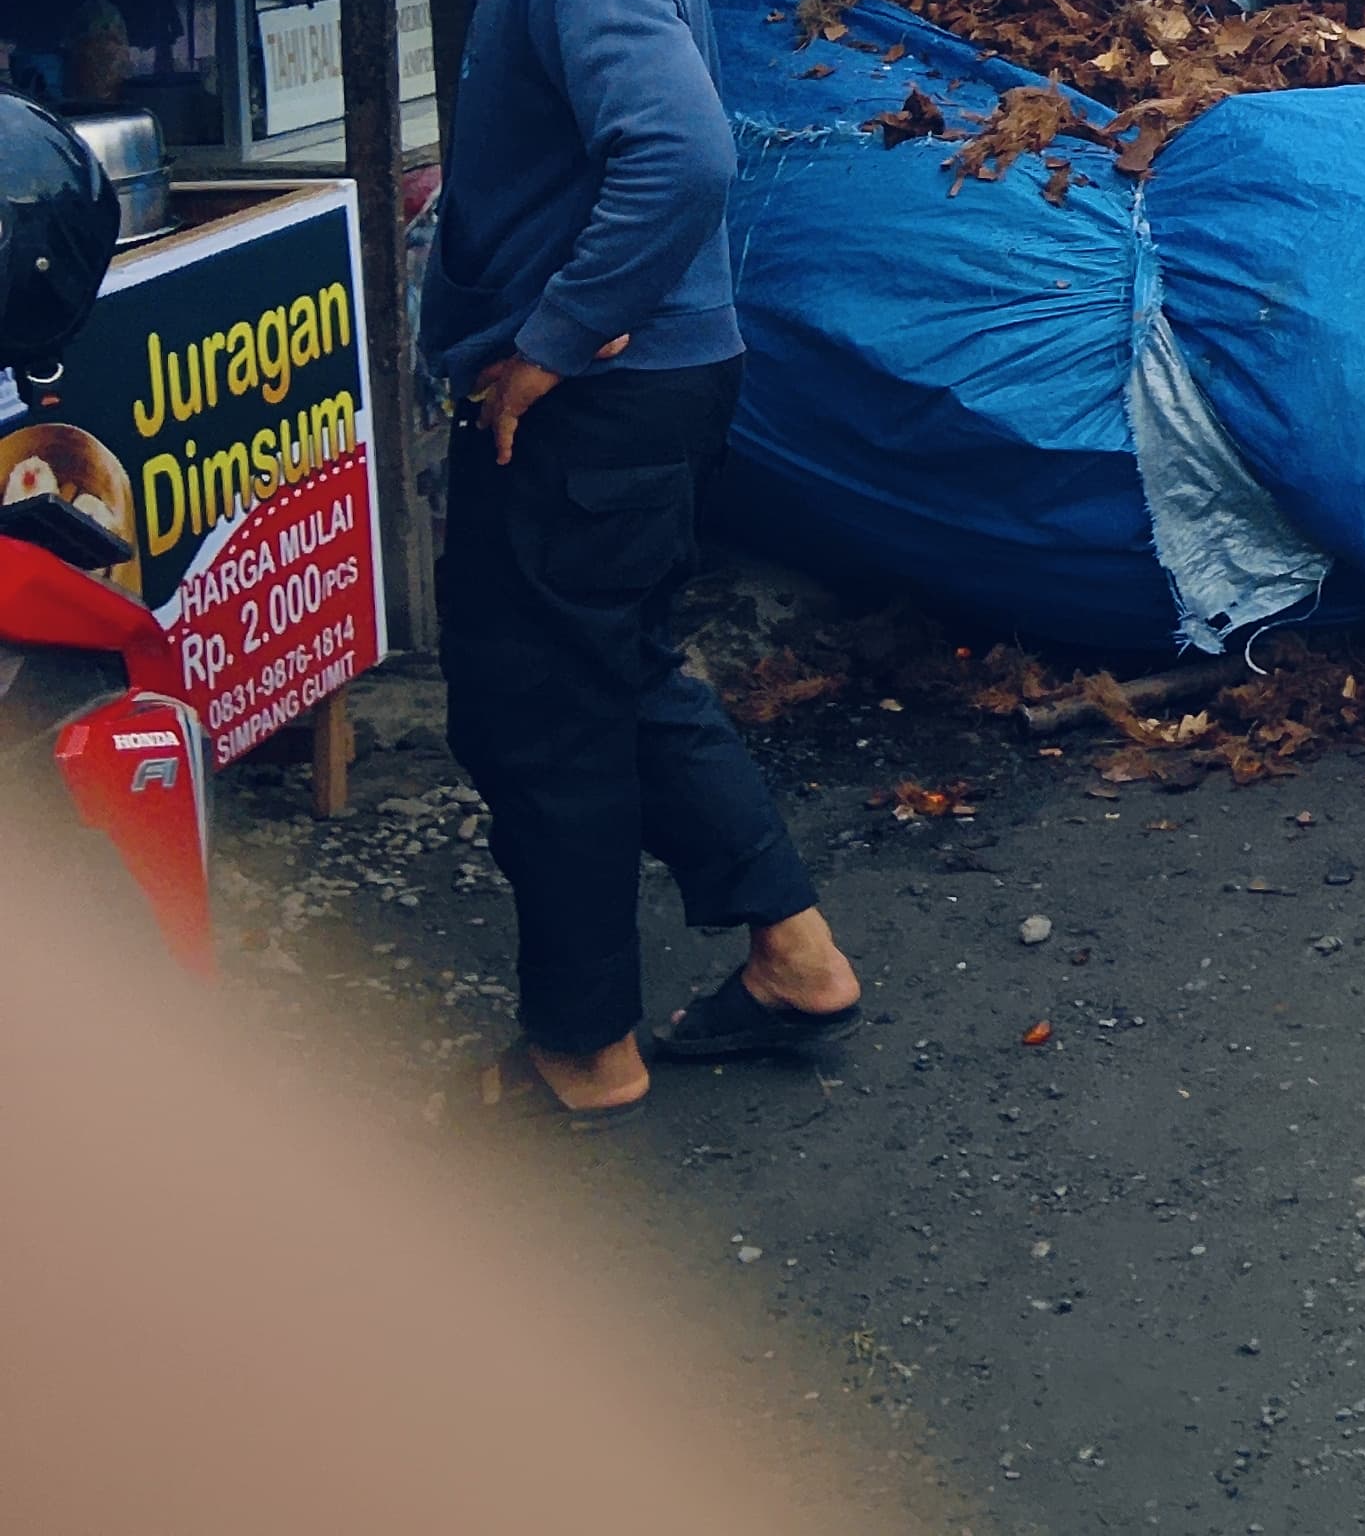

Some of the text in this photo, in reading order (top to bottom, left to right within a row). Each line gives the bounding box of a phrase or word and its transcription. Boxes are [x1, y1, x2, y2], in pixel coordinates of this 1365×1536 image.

[132, 280, 351, 439] Juragan
[141, 389, 357, 557] Dimsum
[180, 494, 355, 623] HARGA MULAI
[181, 629, 234, 691] Rp.
[207, 614, 356, 730] 0831-9876-1814
[216, 650, 356, 765] SIMPANG GUMIT
